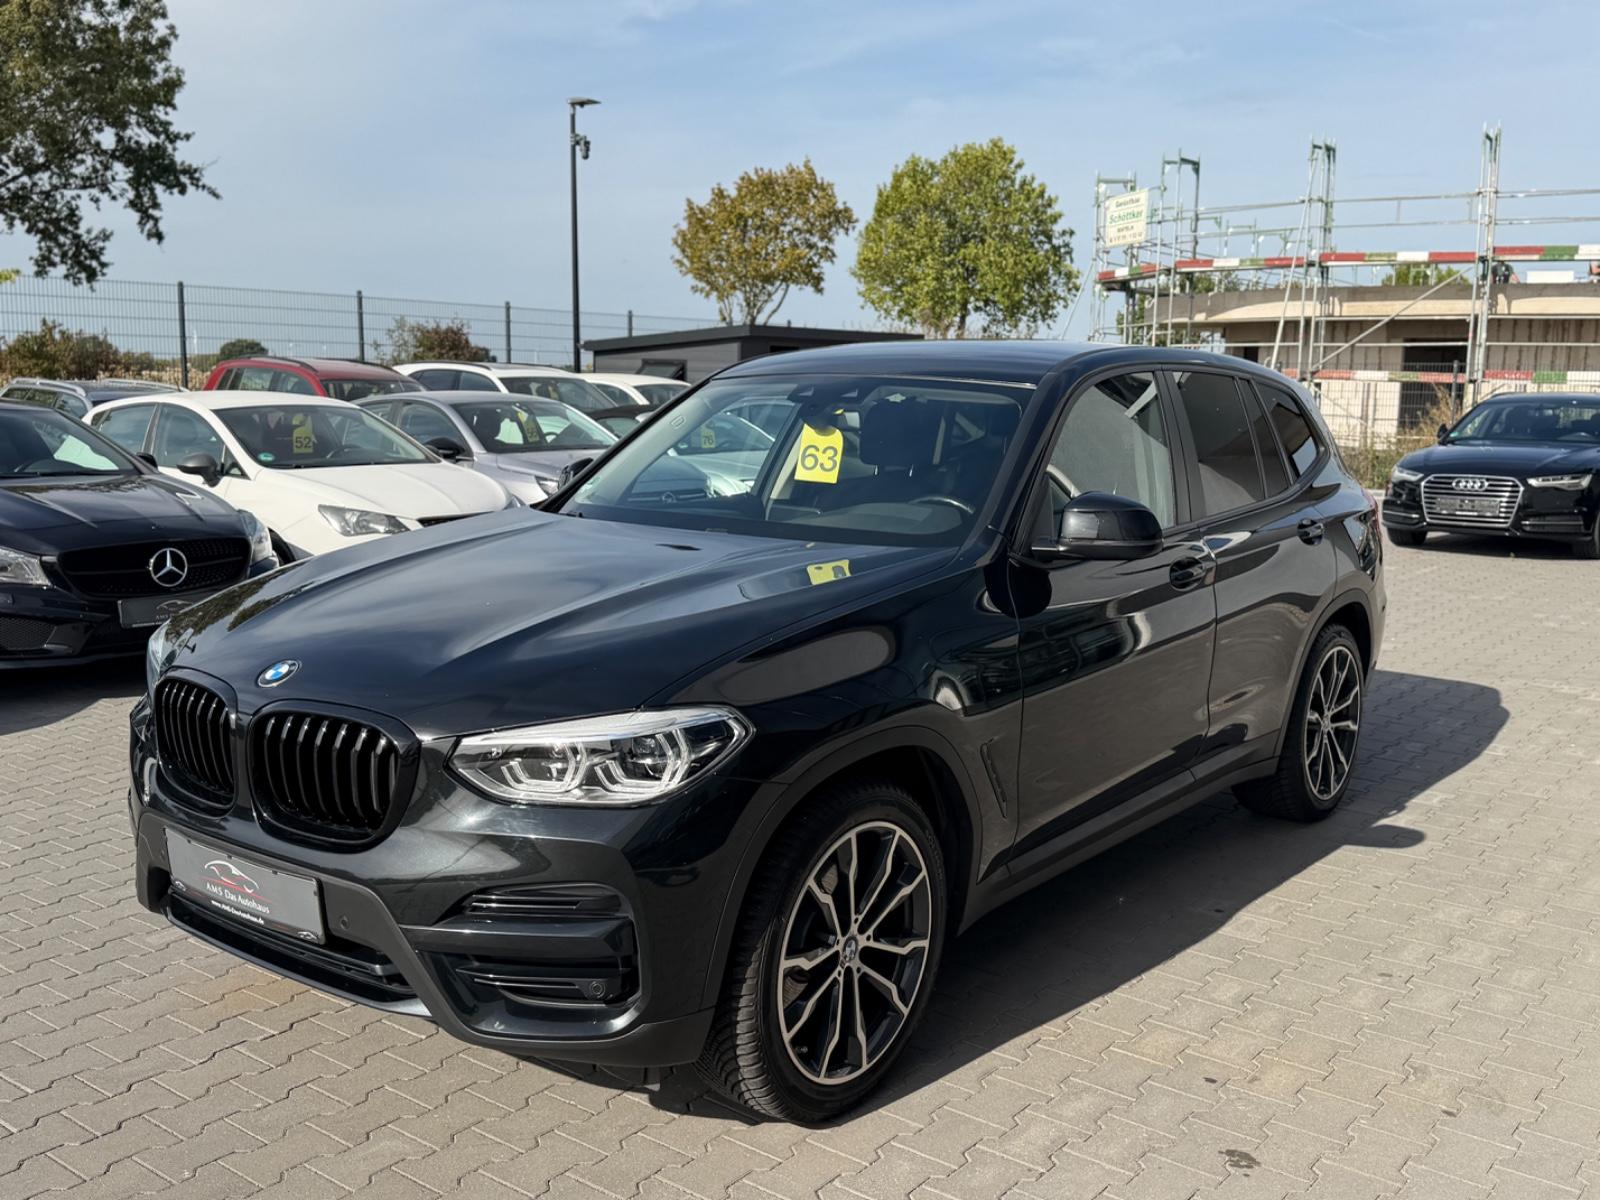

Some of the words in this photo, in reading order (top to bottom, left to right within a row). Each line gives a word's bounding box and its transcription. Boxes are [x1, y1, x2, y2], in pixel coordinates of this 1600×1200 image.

[295, 436, 312, 449] 52
[703, 434, 714, 446] 76
[801, 445, 838, 472] 63
[206, 882, 223, 896] AMS
[224, 889, 237, 902] Das
[237, 894, 270, 914] Autohaus
